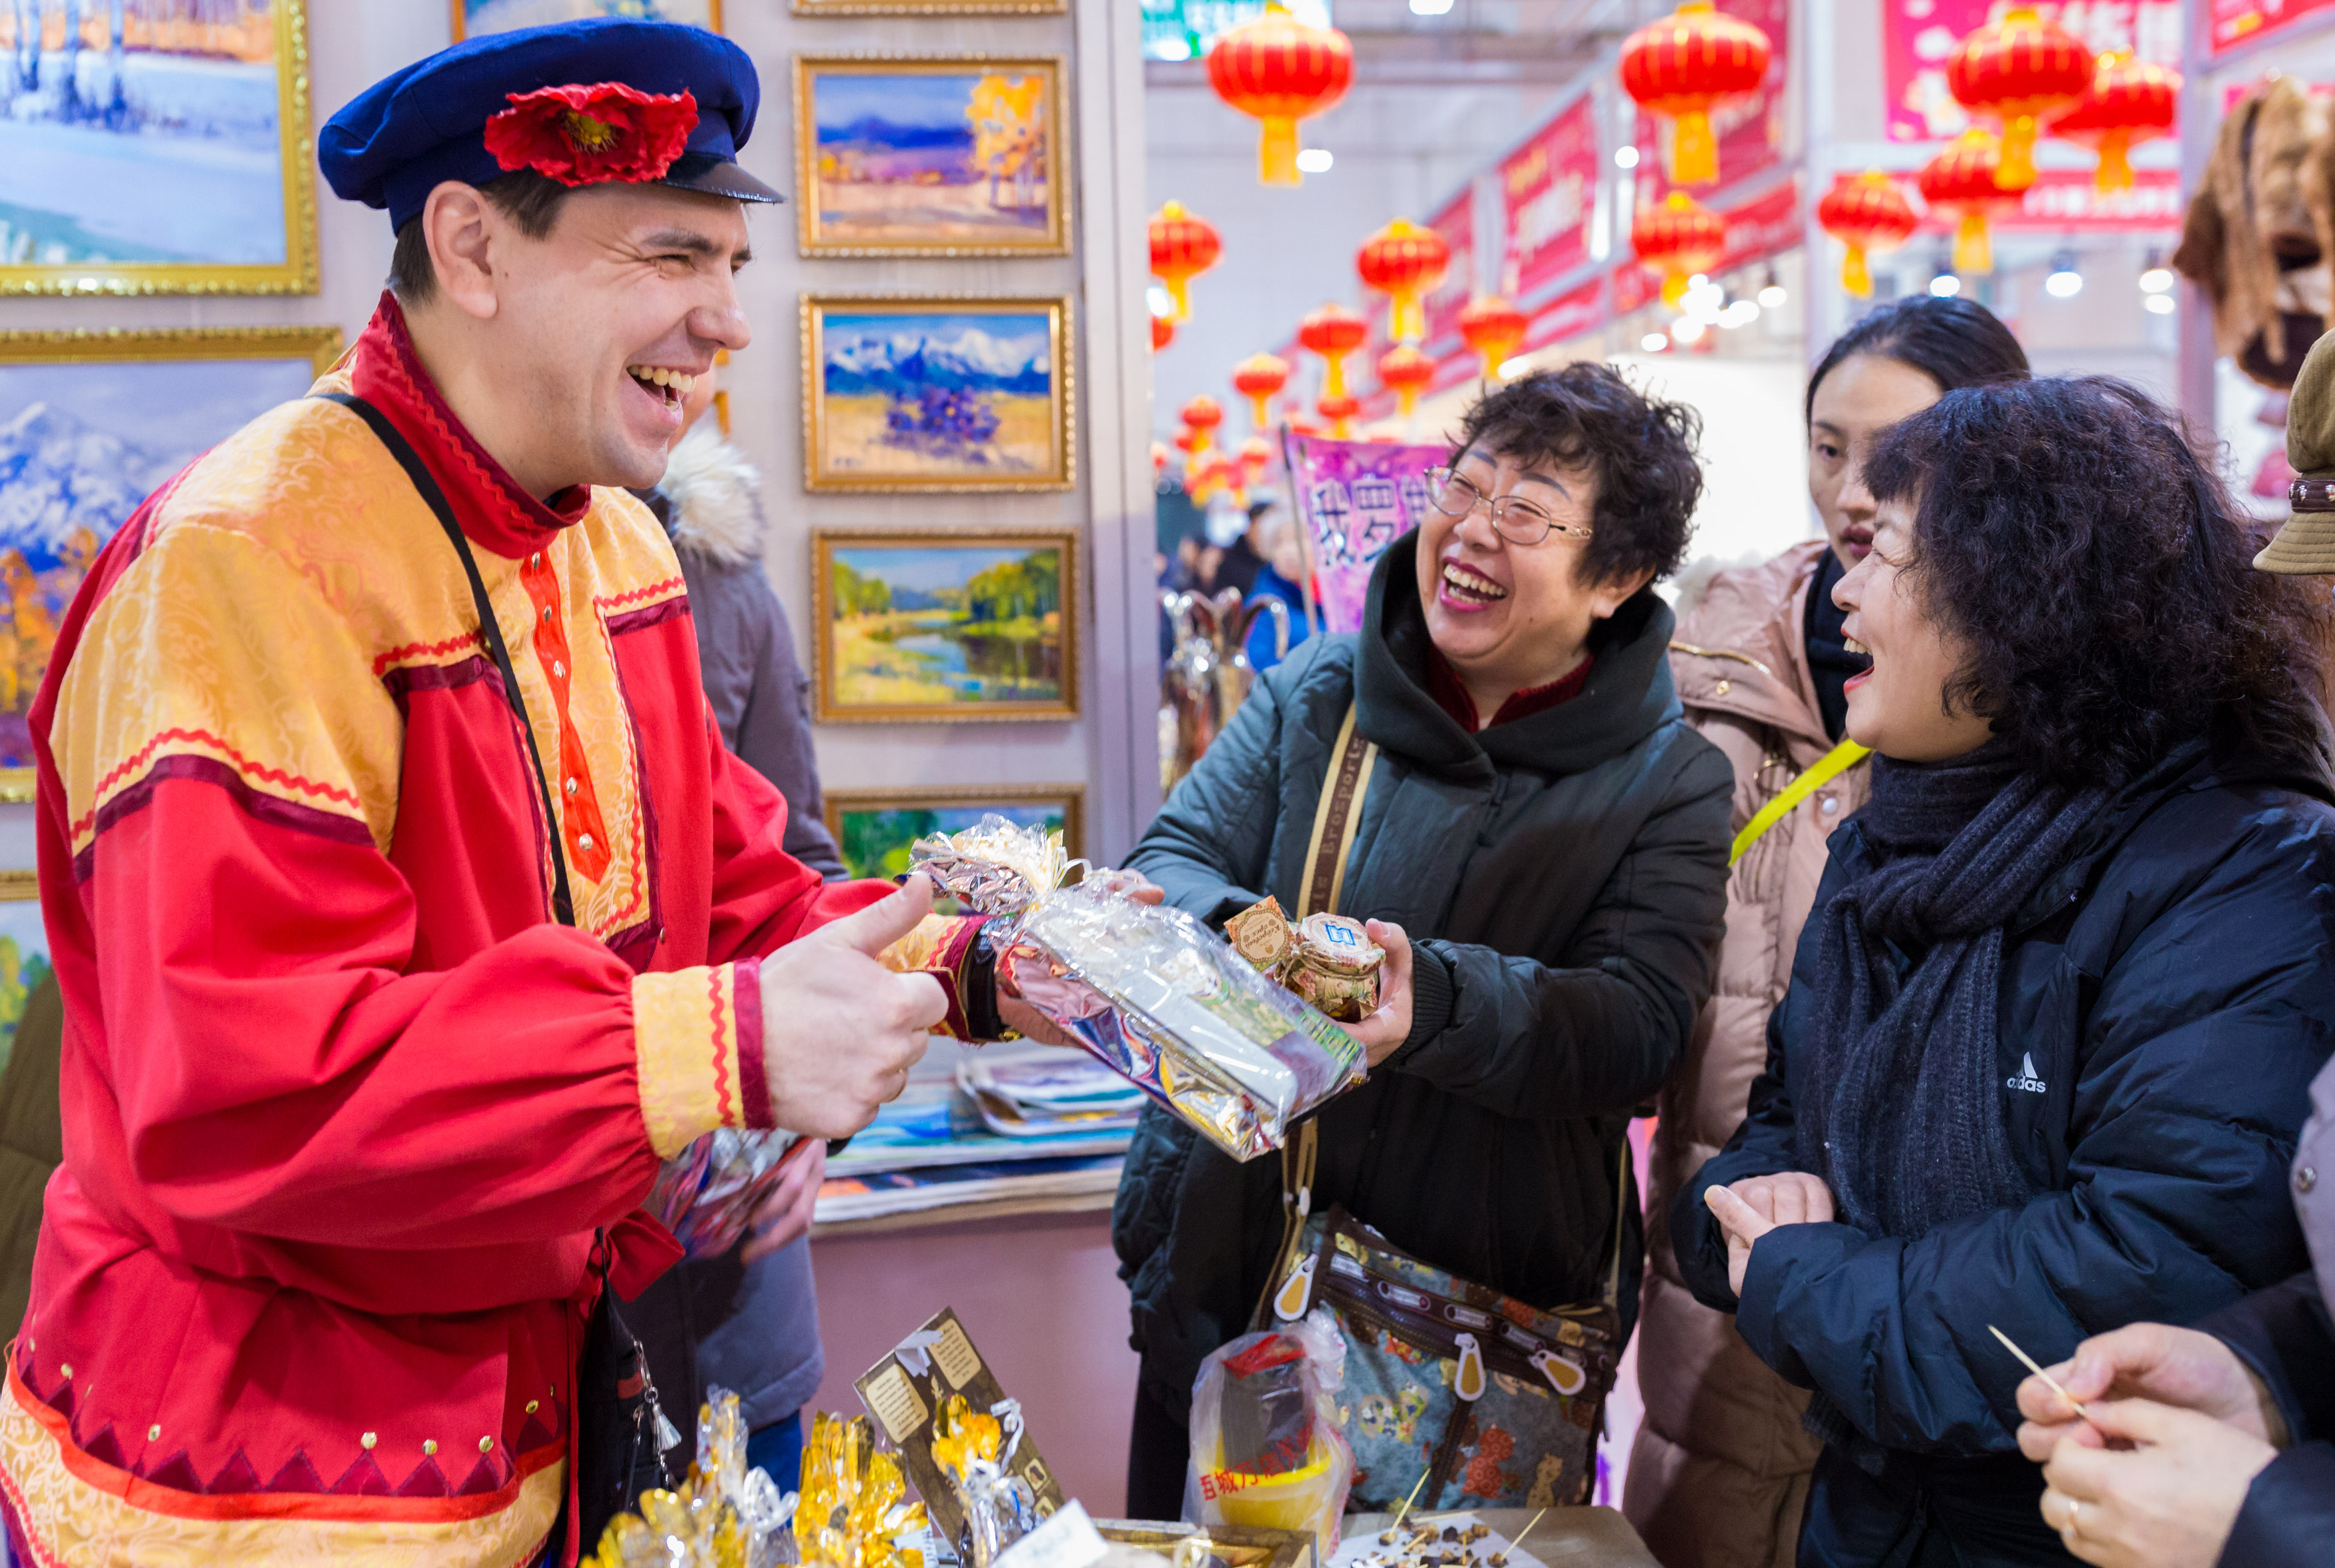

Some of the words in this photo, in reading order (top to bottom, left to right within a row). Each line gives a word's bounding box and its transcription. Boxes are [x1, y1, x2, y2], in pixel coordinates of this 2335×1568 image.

[1245, 924, 1280, 949] Кедровый
[1252, 924, 1268, 936] орех
[2007, 1075, 2046, 1093] adas
